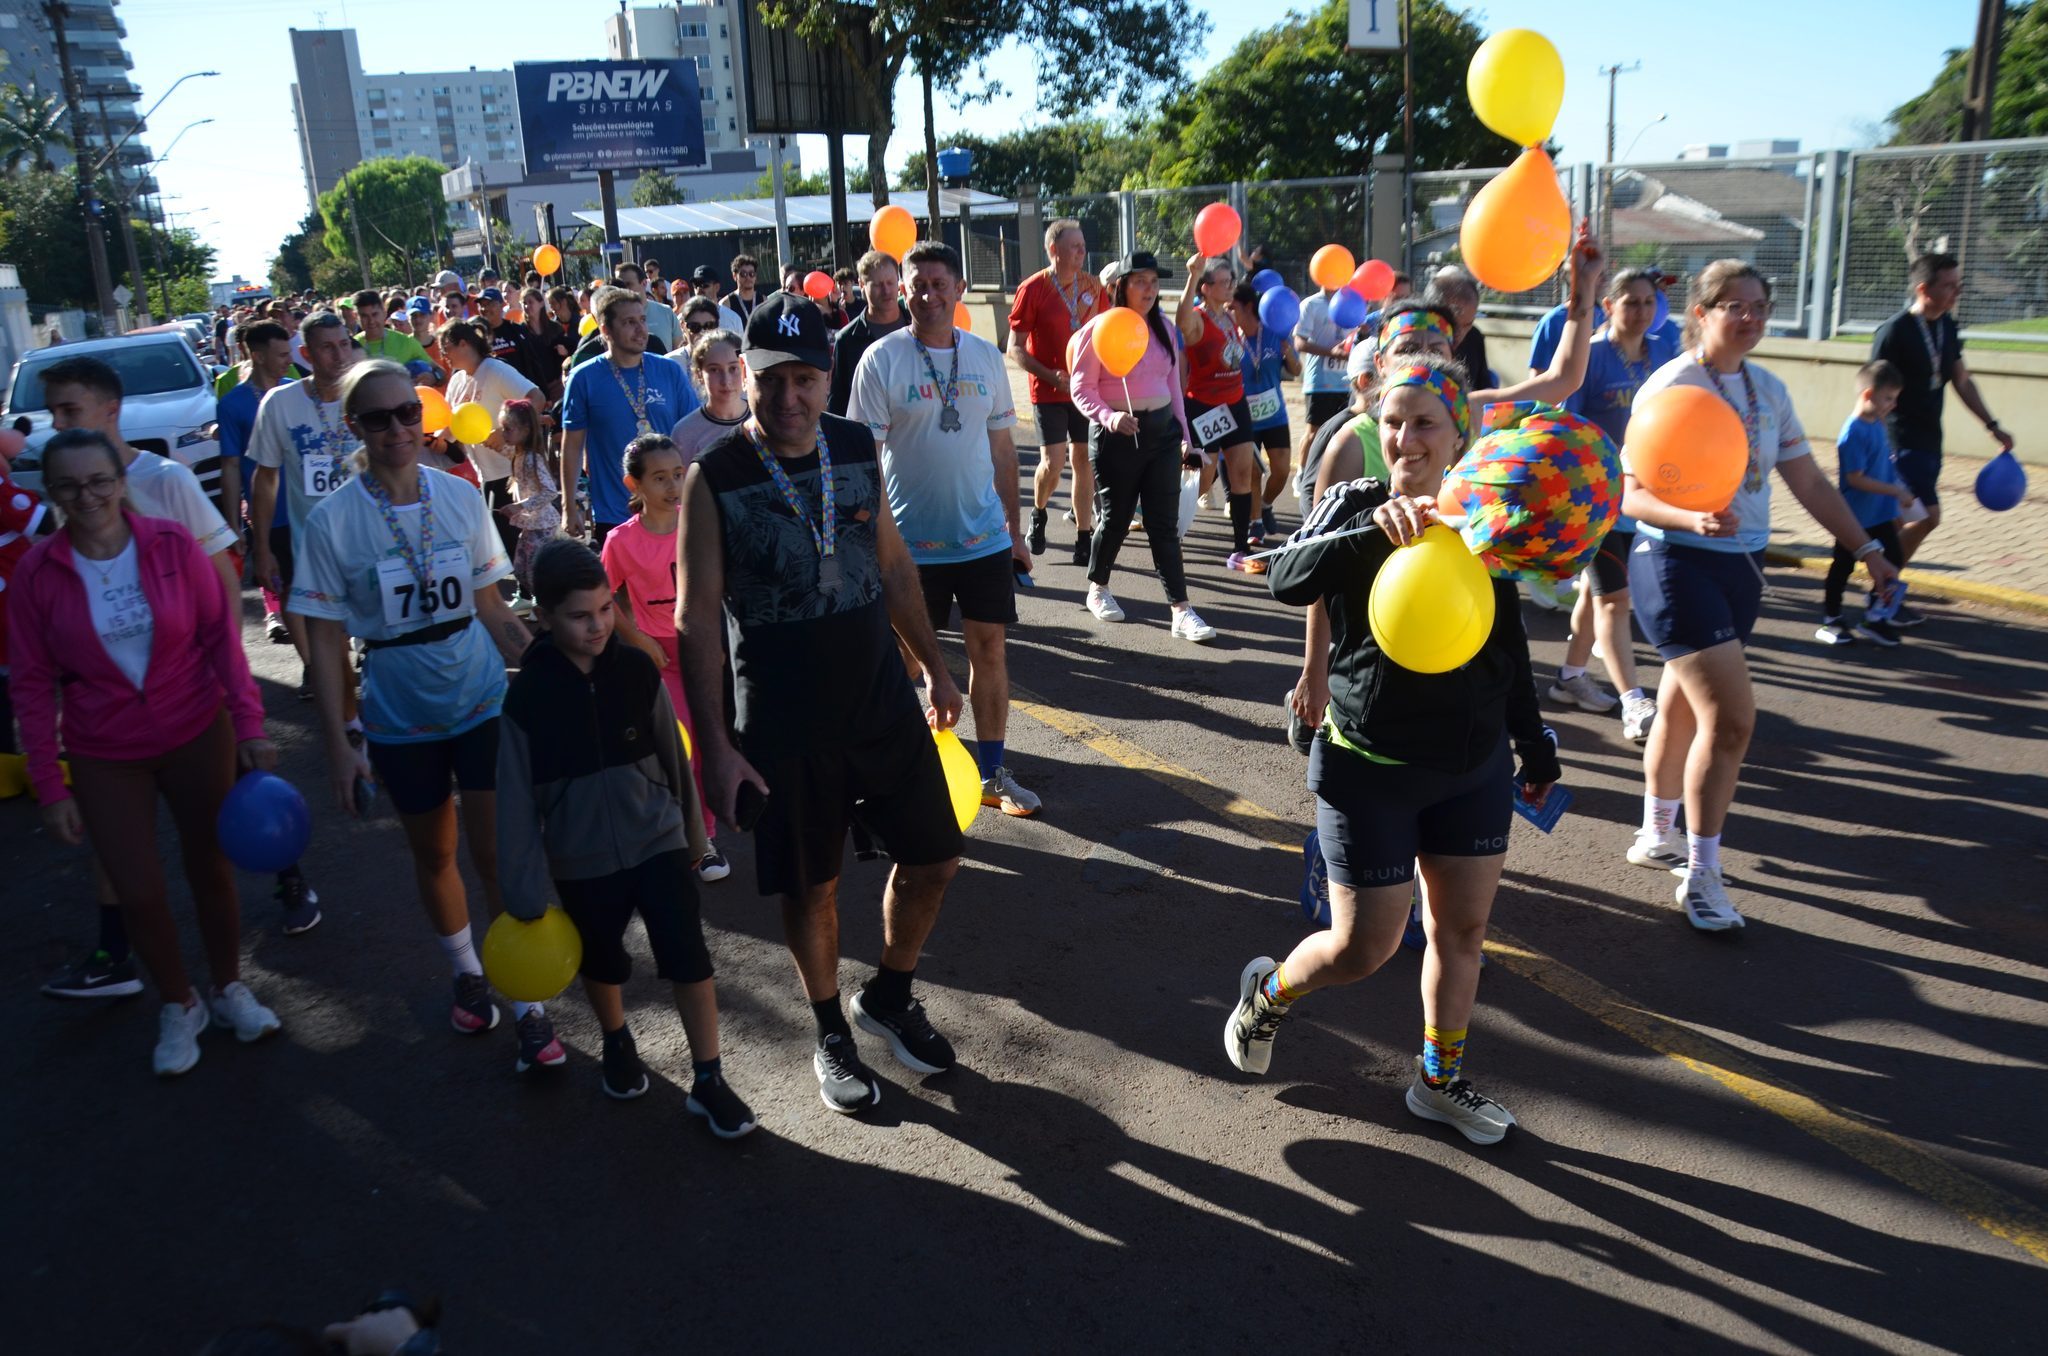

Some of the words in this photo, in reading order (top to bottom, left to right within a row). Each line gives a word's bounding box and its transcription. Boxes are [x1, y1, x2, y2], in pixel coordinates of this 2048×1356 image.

[548, 69, 669, 102] PBNEW
[579, 100, 672, 115] SISTEMAS
[572, 122, 606, 132] Soluções
[607, 120, 654, 131] tecnológicas
[586, 131, 618, 140] produtos
[551, 151, 594, 162] pbnew.com.br
[1251, 399, 1277, 418] 523
[1202, 416, 1231, 440] 843
[393, 576, 462, 619] 750
[1474, 835, 1508, 851] MO
[1363, 865, 1405, 881] RUN
